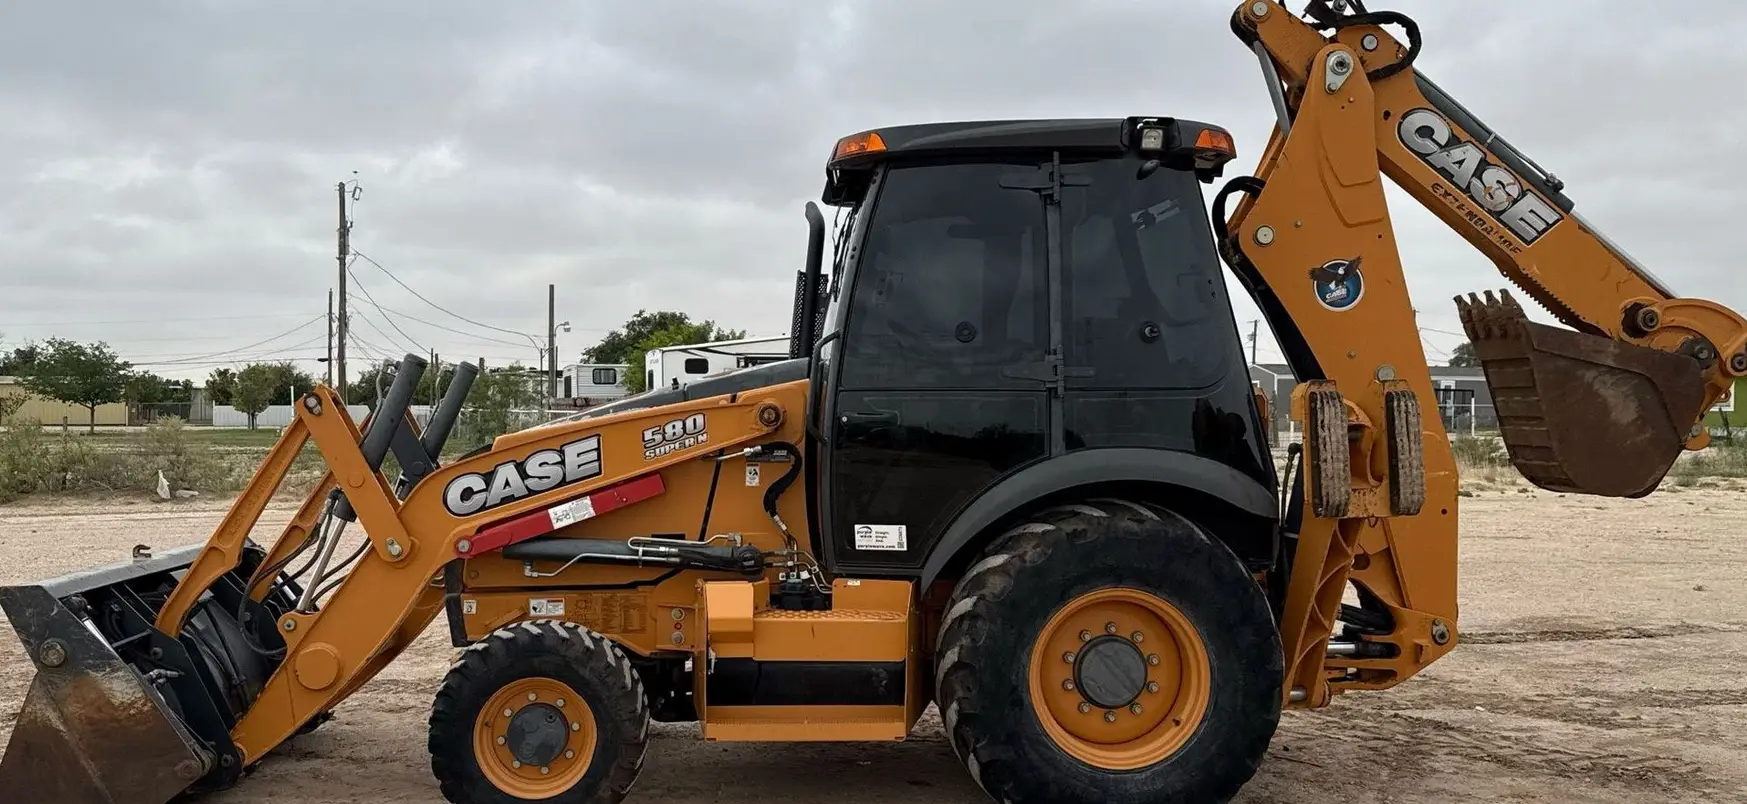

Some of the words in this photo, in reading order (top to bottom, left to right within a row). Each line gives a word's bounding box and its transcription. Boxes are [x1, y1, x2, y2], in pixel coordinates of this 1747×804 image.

[1398, 109, 1563, 244] CASE
[642, 412, 706, 449] 580
[644, 436, 696, 460] SUPER
[697, 432, 709, 445] N
[444, 435, 602, 518] CASE
